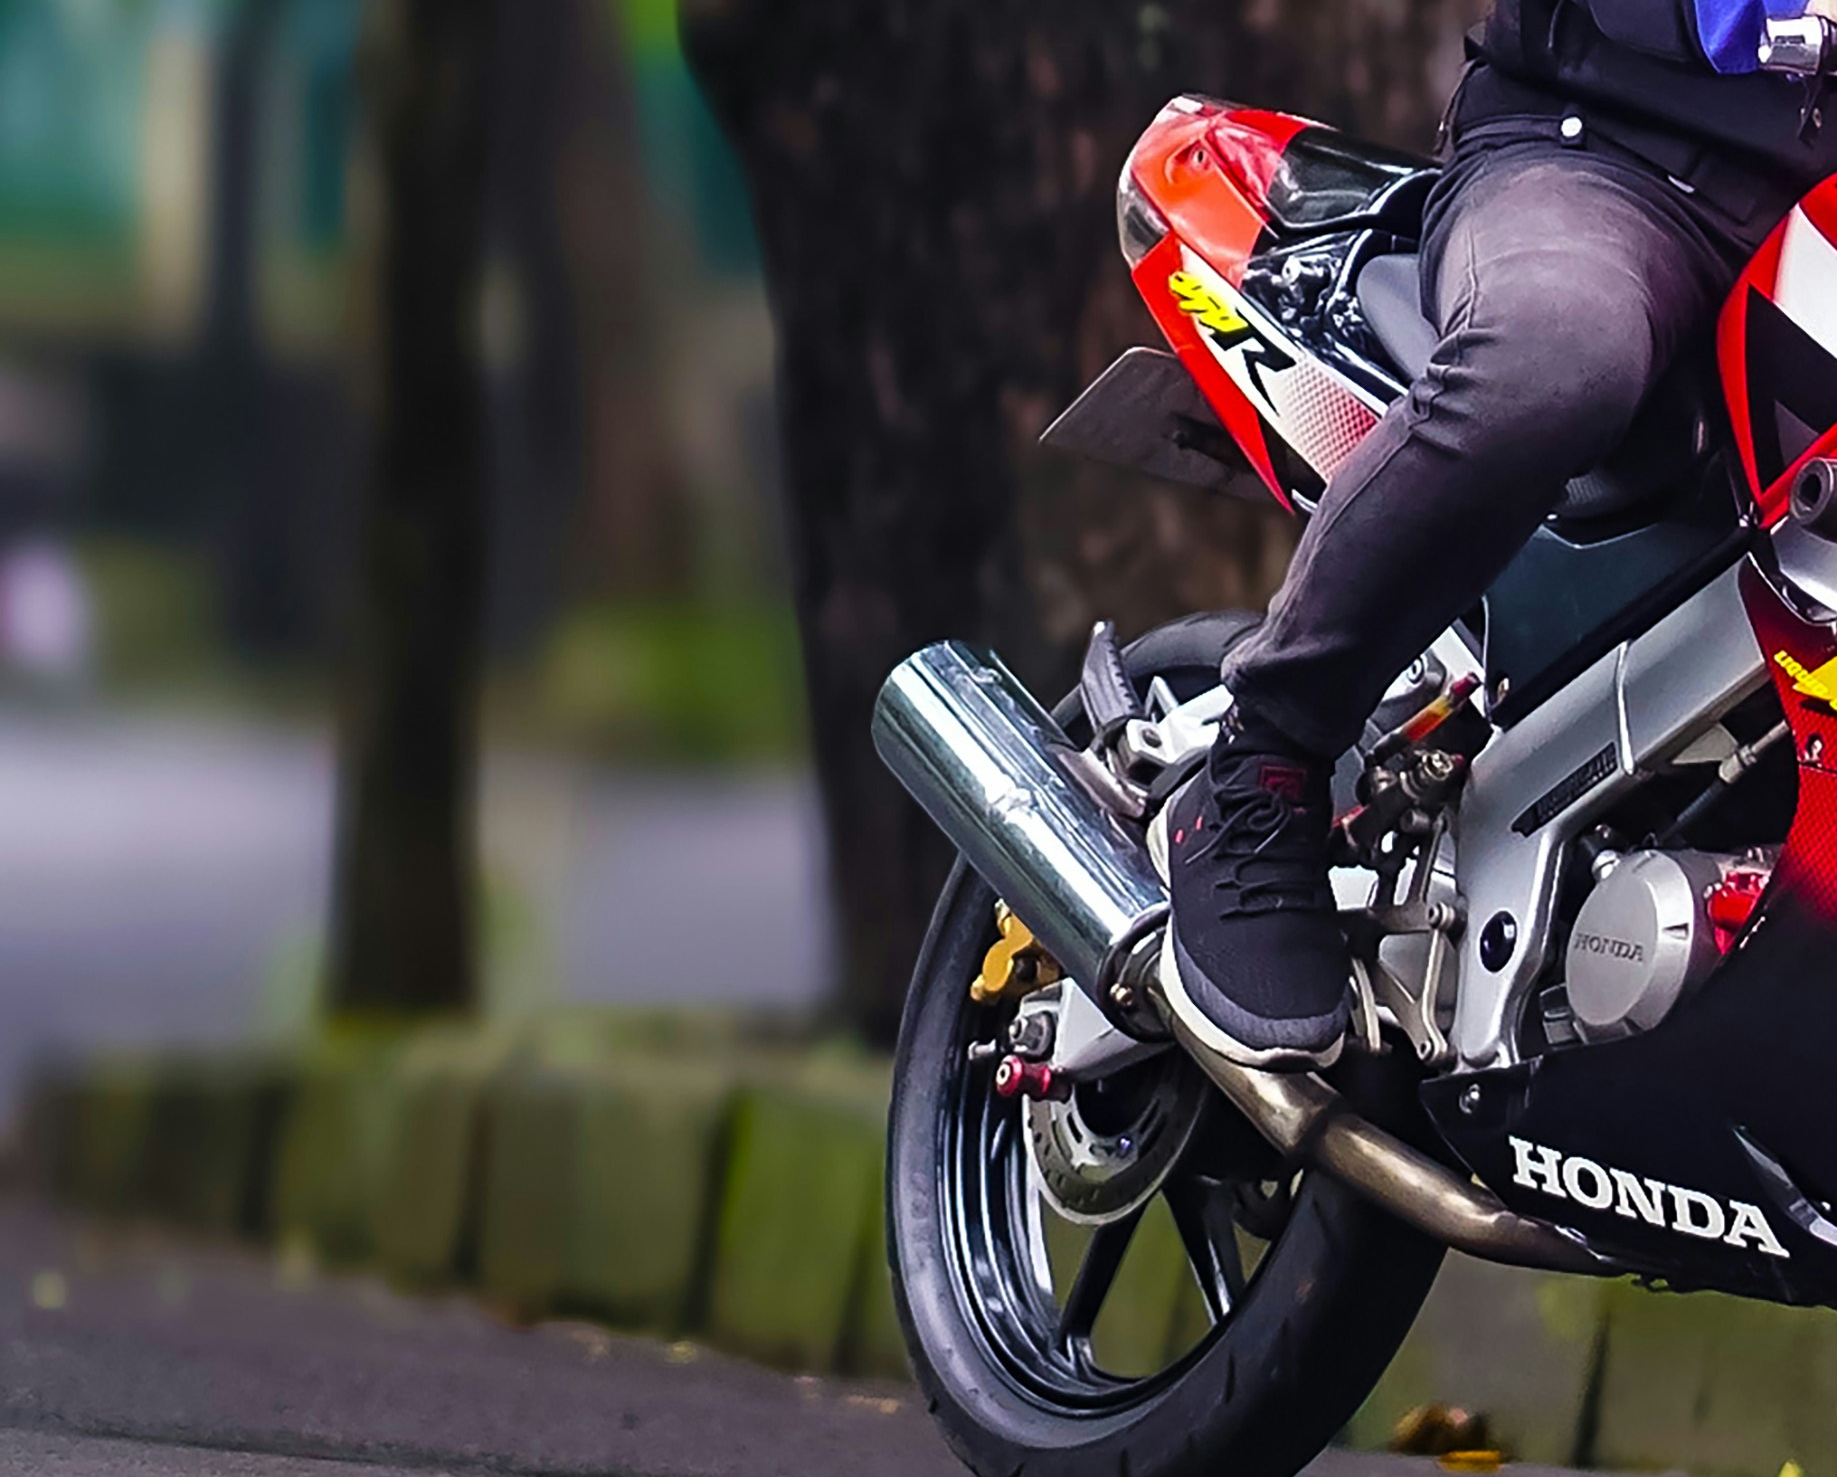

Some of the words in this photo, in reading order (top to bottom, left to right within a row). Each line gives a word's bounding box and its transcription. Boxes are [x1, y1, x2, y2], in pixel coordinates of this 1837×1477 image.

[1774, 650, 1828, 696] LIQUID
[1574, 932, 1643, 962] HONDA
[1508, 1135, 1790, 1259] HONDA
